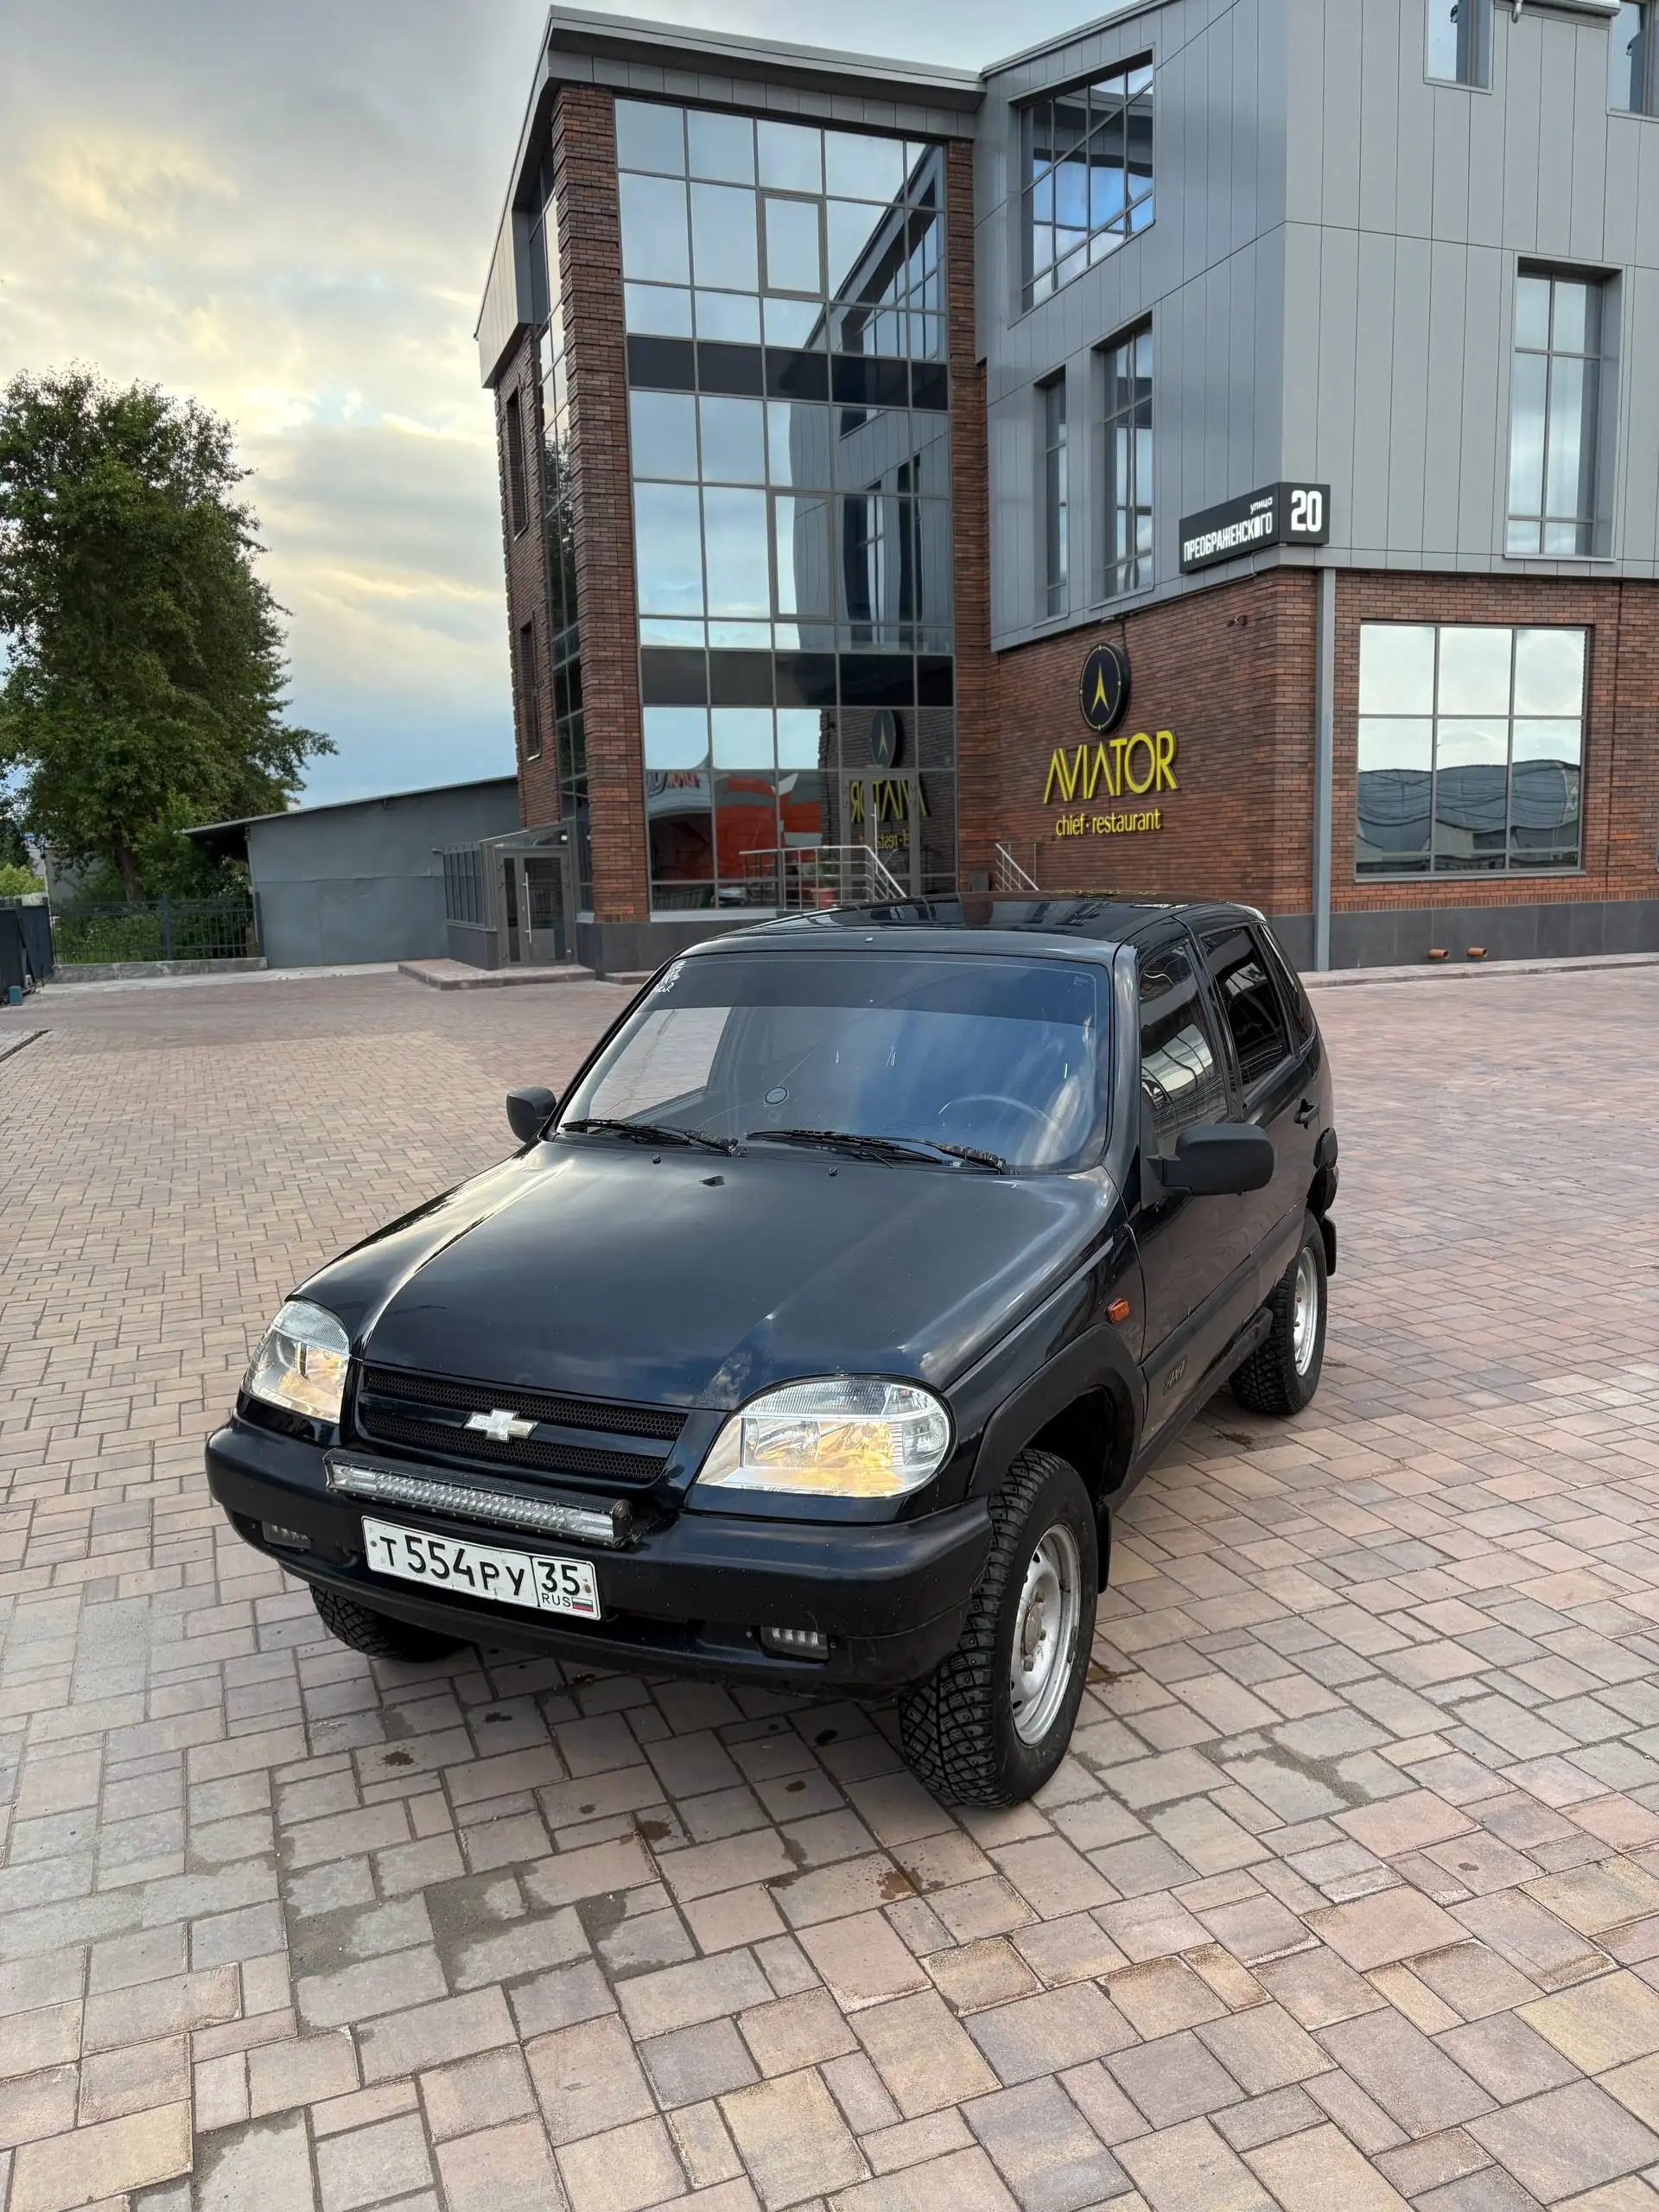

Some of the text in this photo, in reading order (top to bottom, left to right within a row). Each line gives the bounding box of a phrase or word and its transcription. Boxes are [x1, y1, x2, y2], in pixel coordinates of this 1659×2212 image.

[1250, 497, 1273, 515] улица
[1291, 490, 1323, 532] 20
[1184, 512, 1273, 562] ПРЕОБРАЖЕНСКОГО
[1043, 730, 1179, 804] AVIATOR
[537, 1561, 580, 1596] 35
[541, 1592, 570, 1608] RUS
